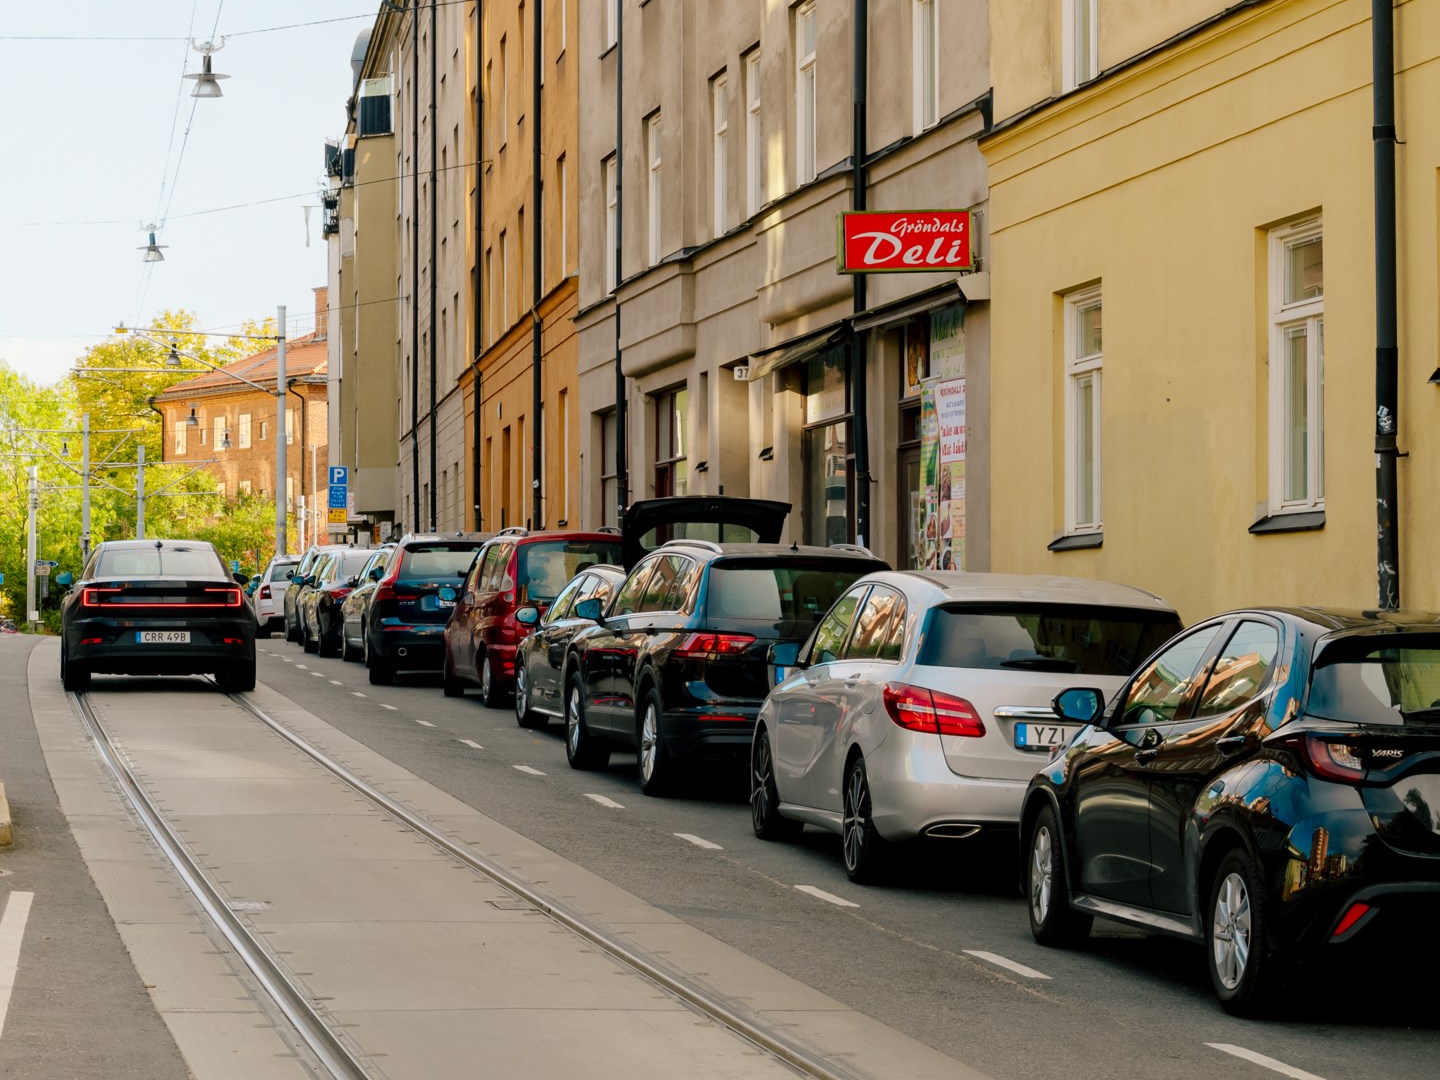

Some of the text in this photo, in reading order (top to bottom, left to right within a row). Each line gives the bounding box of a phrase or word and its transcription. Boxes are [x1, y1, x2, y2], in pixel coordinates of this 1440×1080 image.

[890, 218, 964, 237] Gröndals
[851, 232, 961, 265] Deli
[738, 368, 749, 378] 37
[334, 469, 344, 483] P
[144, 632, 186, 642] CRR 49B
[1371, 749, 1404, 758] YARIS
